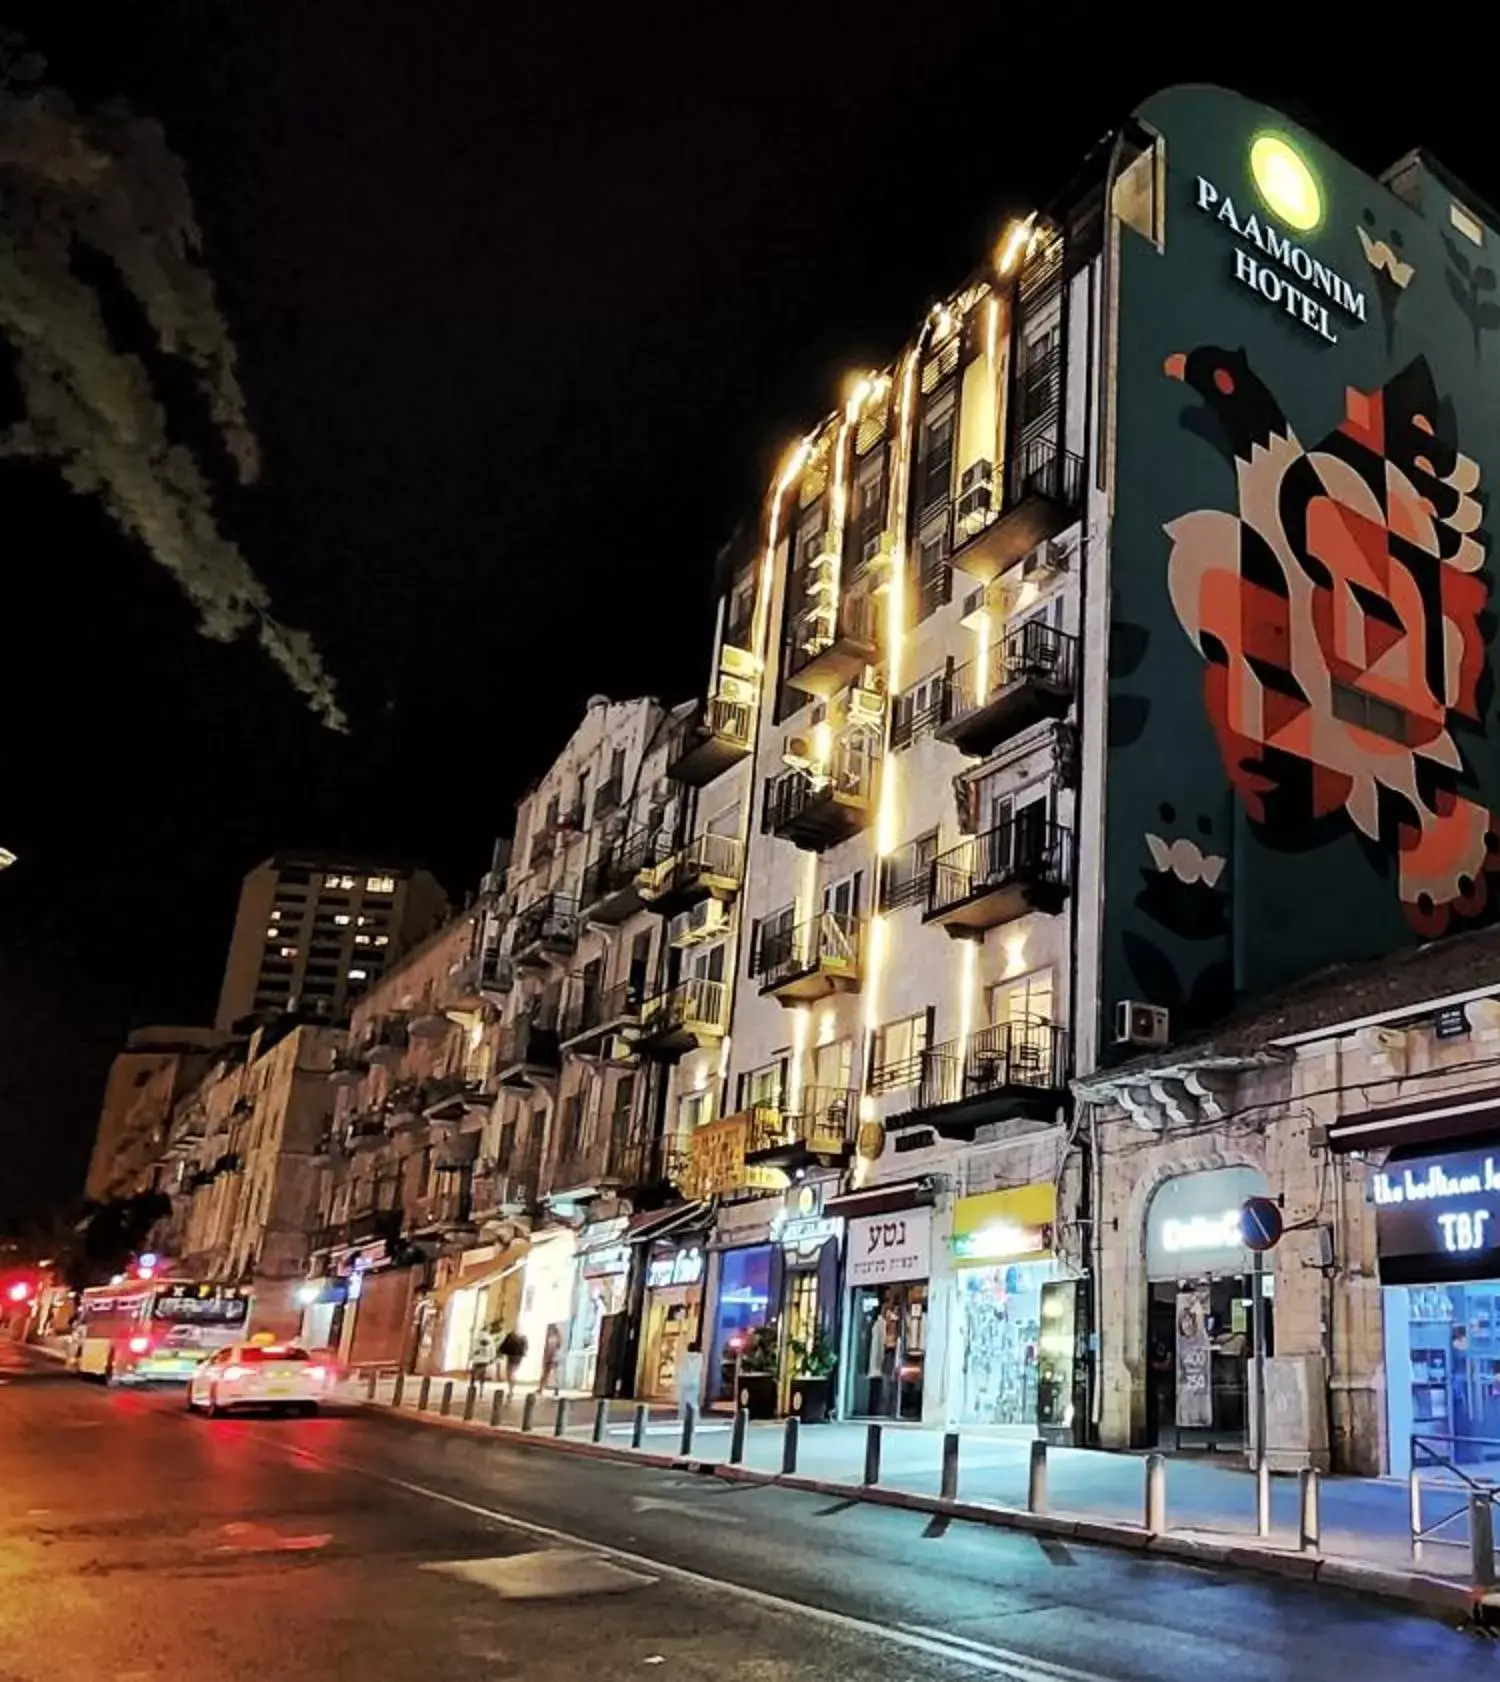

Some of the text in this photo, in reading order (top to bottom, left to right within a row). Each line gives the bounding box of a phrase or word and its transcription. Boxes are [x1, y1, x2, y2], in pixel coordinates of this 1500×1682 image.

[1196, 176, 1367, 323] PAAMONIM
[1233, 248, 1338, 344] HOTEL
[1373, 1171, 1403, 1204] the
[868, 1221, 906, 1255] נטע
